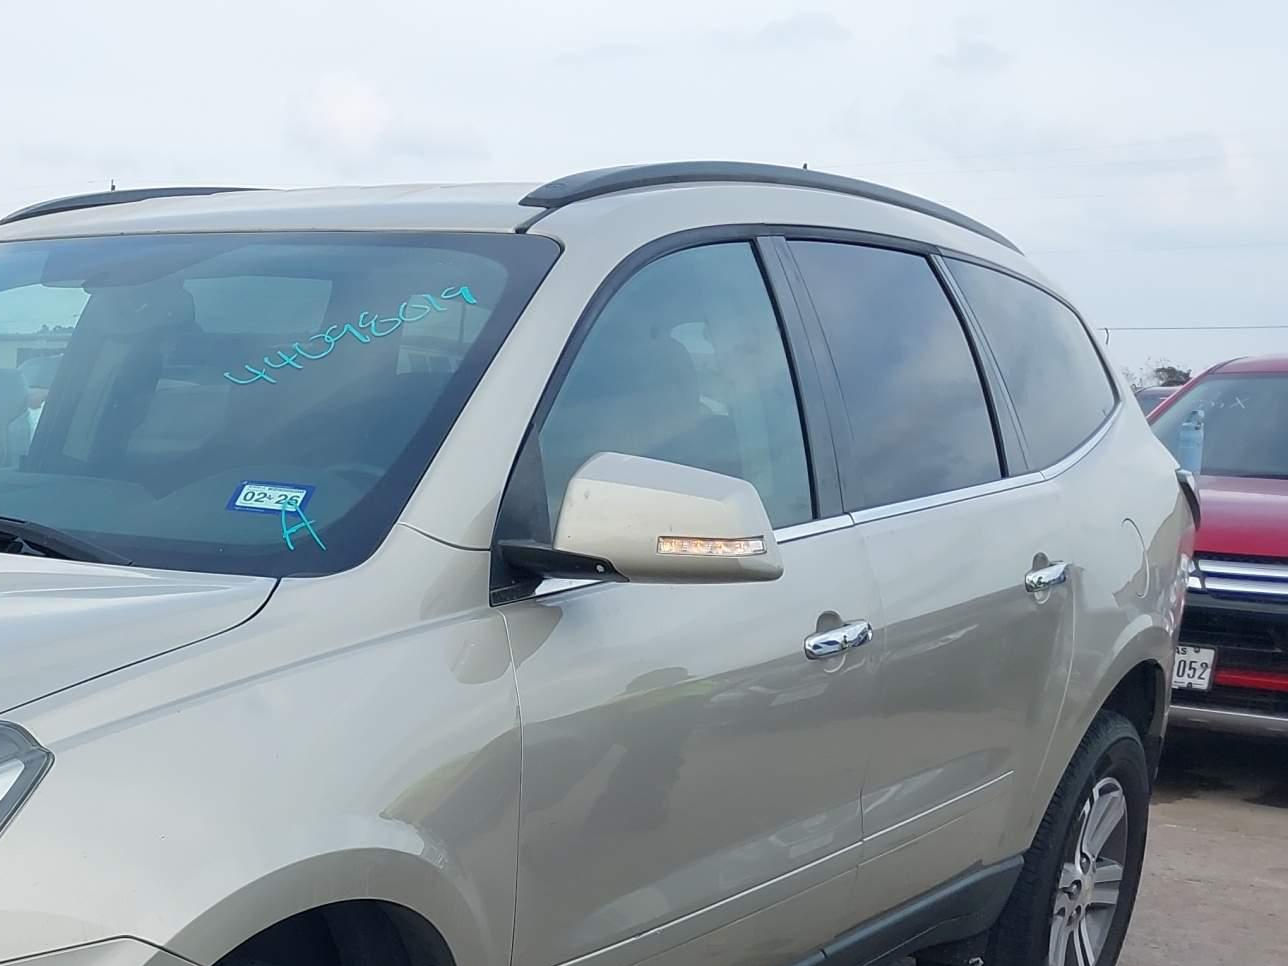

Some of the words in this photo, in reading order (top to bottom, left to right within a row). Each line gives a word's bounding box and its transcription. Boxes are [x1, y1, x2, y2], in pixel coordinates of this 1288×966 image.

[243, 491, 267, 503] 02
[281, 501, 327, 551] A
[1176, 659, 1209, 680] 052
